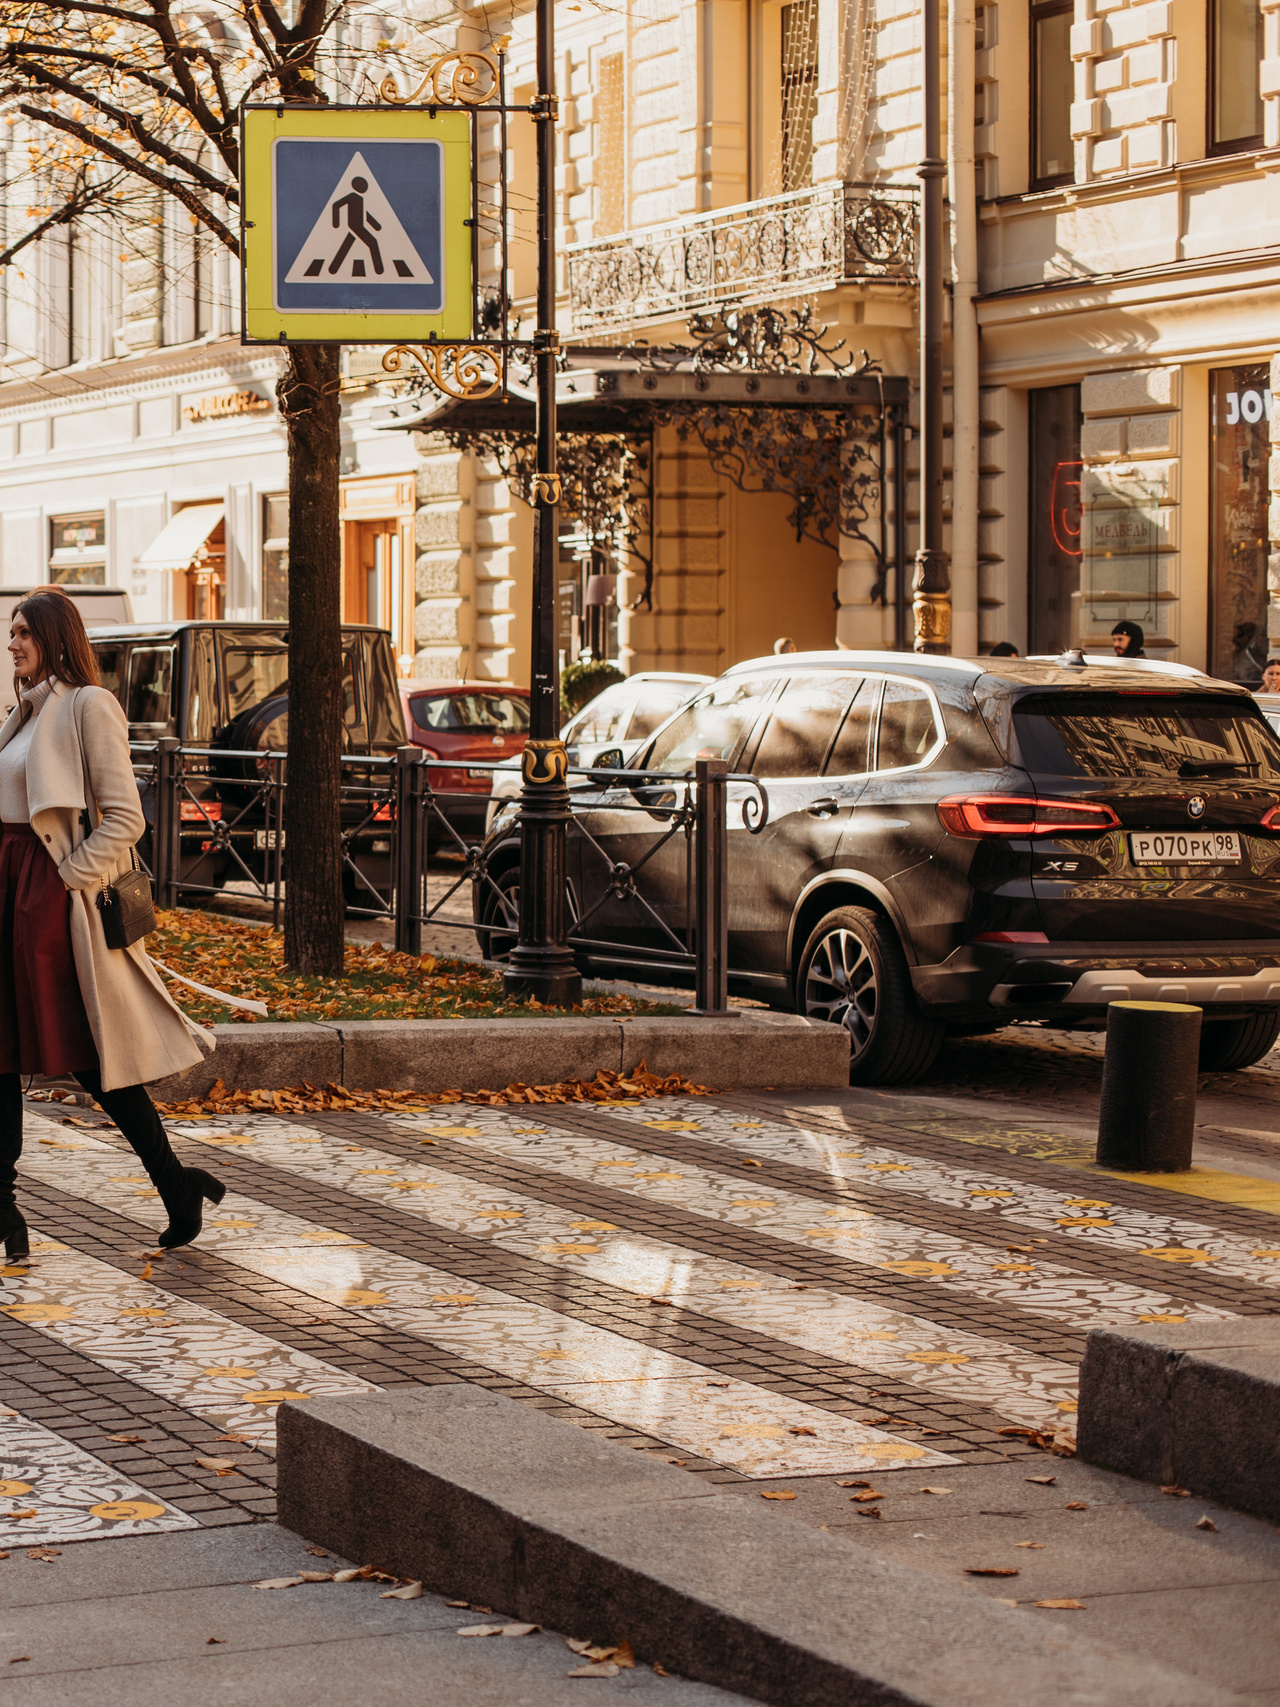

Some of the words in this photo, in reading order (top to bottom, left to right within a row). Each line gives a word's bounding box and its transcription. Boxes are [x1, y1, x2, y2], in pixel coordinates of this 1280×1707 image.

[1095, 523, 1148, 538] МЕДВЕДЬ
[1216, 835, 1234, 851] 98
[1043, 861, 1079, 871] X5
